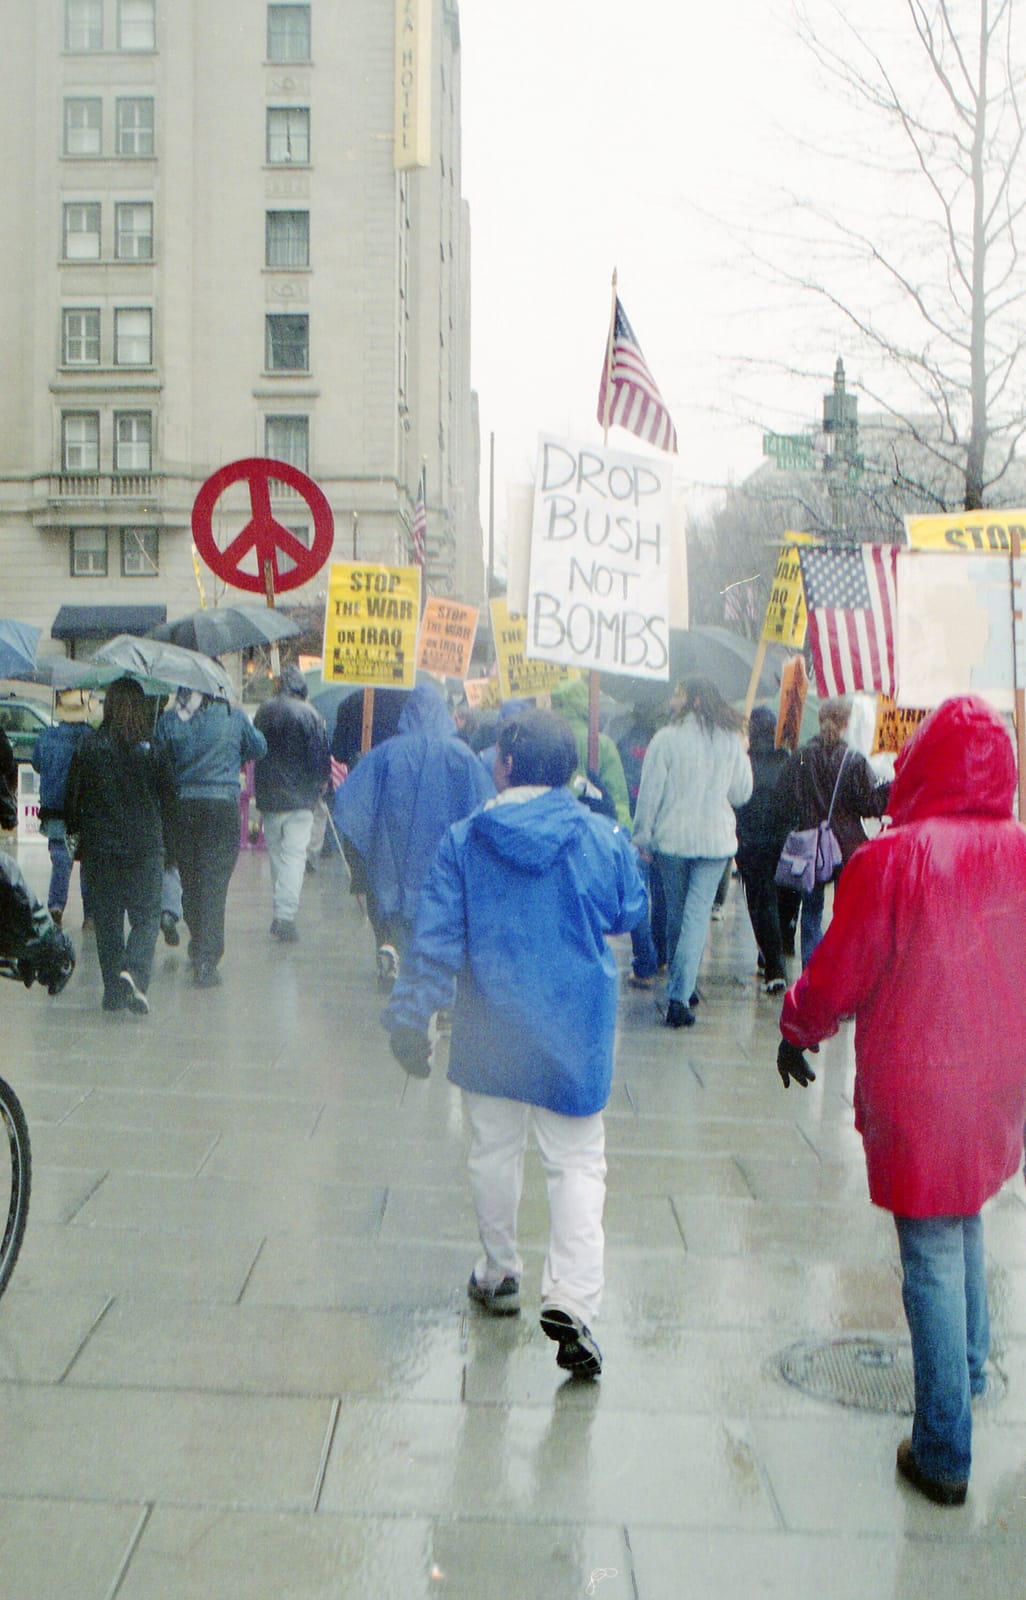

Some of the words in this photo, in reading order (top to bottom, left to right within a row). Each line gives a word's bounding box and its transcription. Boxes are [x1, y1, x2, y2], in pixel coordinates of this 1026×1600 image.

[541, 442, 662, 507] DROP
[542, 494, 661, 565] BUSH
[944, 523, 1026, 549] STOP
[350, 570, 401, 593] STOP
[568, 555, 641, 601] NOT
[335, 600, 360, 616] THE
[366, 596, 413, 620] WAR
[437, 605, 467, 621] STOP
[337, 630, 355, 644] ON
[360, 626, 402, 648] IRAQ
[445, 622, 471, 640] WAR
[533, 591, 669, 670] BOMBS
